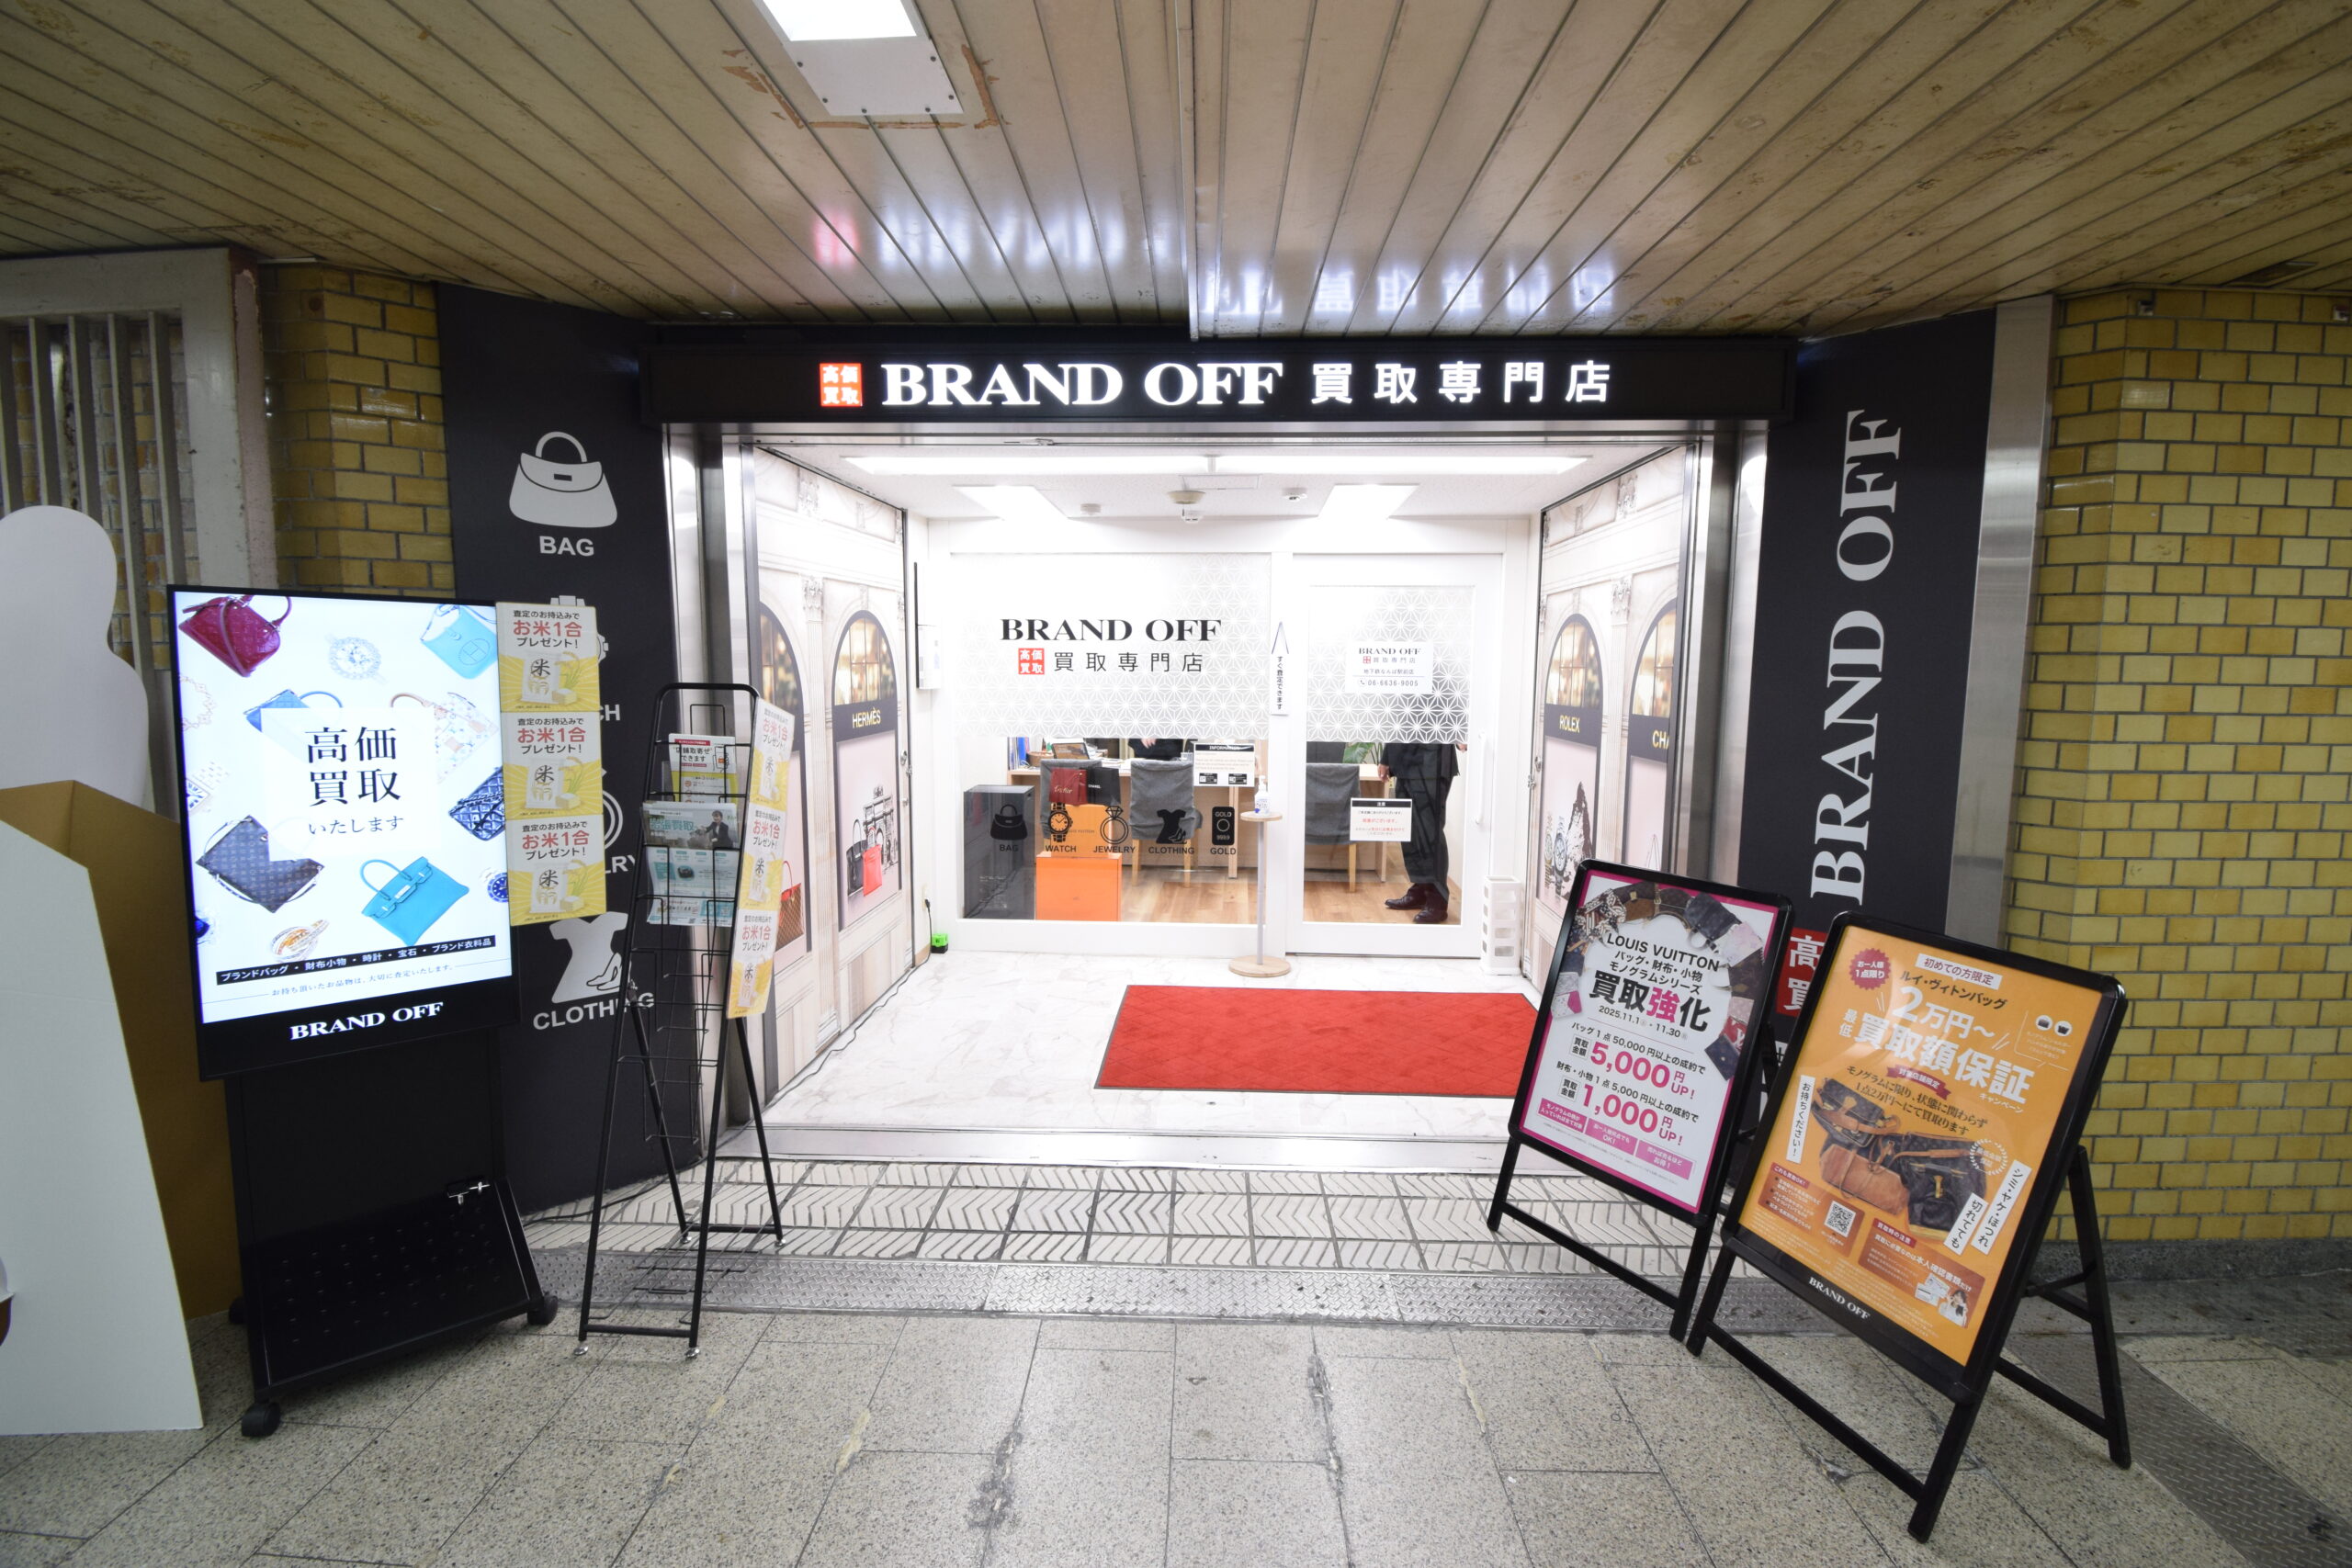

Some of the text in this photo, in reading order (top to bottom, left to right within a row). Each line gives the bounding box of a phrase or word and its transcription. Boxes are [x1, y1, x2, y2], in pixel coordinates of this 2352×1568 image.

[823, 365, 858, 383] 高価
[880, 360, 1611, 407] BRAND OFF 買取専門店
[823, 387, 859, 404] 買取
[539, 536, 594, 557] BAG
[513, 620, 582, 637] お米1合
[1000, 619, 1222, 641] BRAND OFF
[516, 637, 579, 649] プレゼント!
[1054, 651, 1204, 672] 買取専門店
[1810, 409, 1902, 906] BRAND OFF
[853, 707, 881, 728] HERMÈS
[1559, 715, 1580, 734] ROLEX
[305, 727, 397, 763] 高価
[517, 727, 586, 743] お米1合
[521, 743, 582, 754] プレゼント!
[310, 769, 401, 807] 買取
[308, 816, 404, 835] いたします
[522, 821, 588, 832] 査定のお持込みで
[522, 829, 590, 850] お米1合
[999, 843, 1019, 852] BAG
[1045, 844, 1077, 853] WATCH
[1093, 845, 1136, 853] JEWELRY
[526, 847, 586, 861] プレゼント!
[1148, 846, 1194, 855] CLOTHING
[1210, 847, 1237, 855] GOLD
[1607, 932, 1720, 973] LOUIS VUITTON
[1614, 950, 1703, 983] バッグ・財布・小物
[1855, 969, 1885, 979] 1点限り
[1857, 961, 1884, 969] お一人様
[1924, 957, 1995, 987] 初めての方限定
[1610, 961, 1703, 996] モノグラムシリーズ
[1900, 970, 2008, 1010] ルイ・ヴィトンバッグ
[1589, 970, 1712, 1032] 買取強化
[289, 1001, 444, 1041] BRAND OFF
[1838, 1009, 1858, 1038] 最低
[1574, 1036, 1589, 1048] 買取
[1590, 1041, 1670, 1089] 5,000
[1854, 1012, 2036, 1104] 買取額保証
[1563, 1077, 1578, 1091] 買取
[1583, 1084, 1658, 1134] 1,000
[1979, 1092, 2024, 1114] キャンペーン
[1978, 1168, 2024, 1248] シミ・ヤケ・ほつれ
[1951, 1199, 1980, 1249] 切れてても
[1808, 1276, 1871, 1321] BRAND OFF
